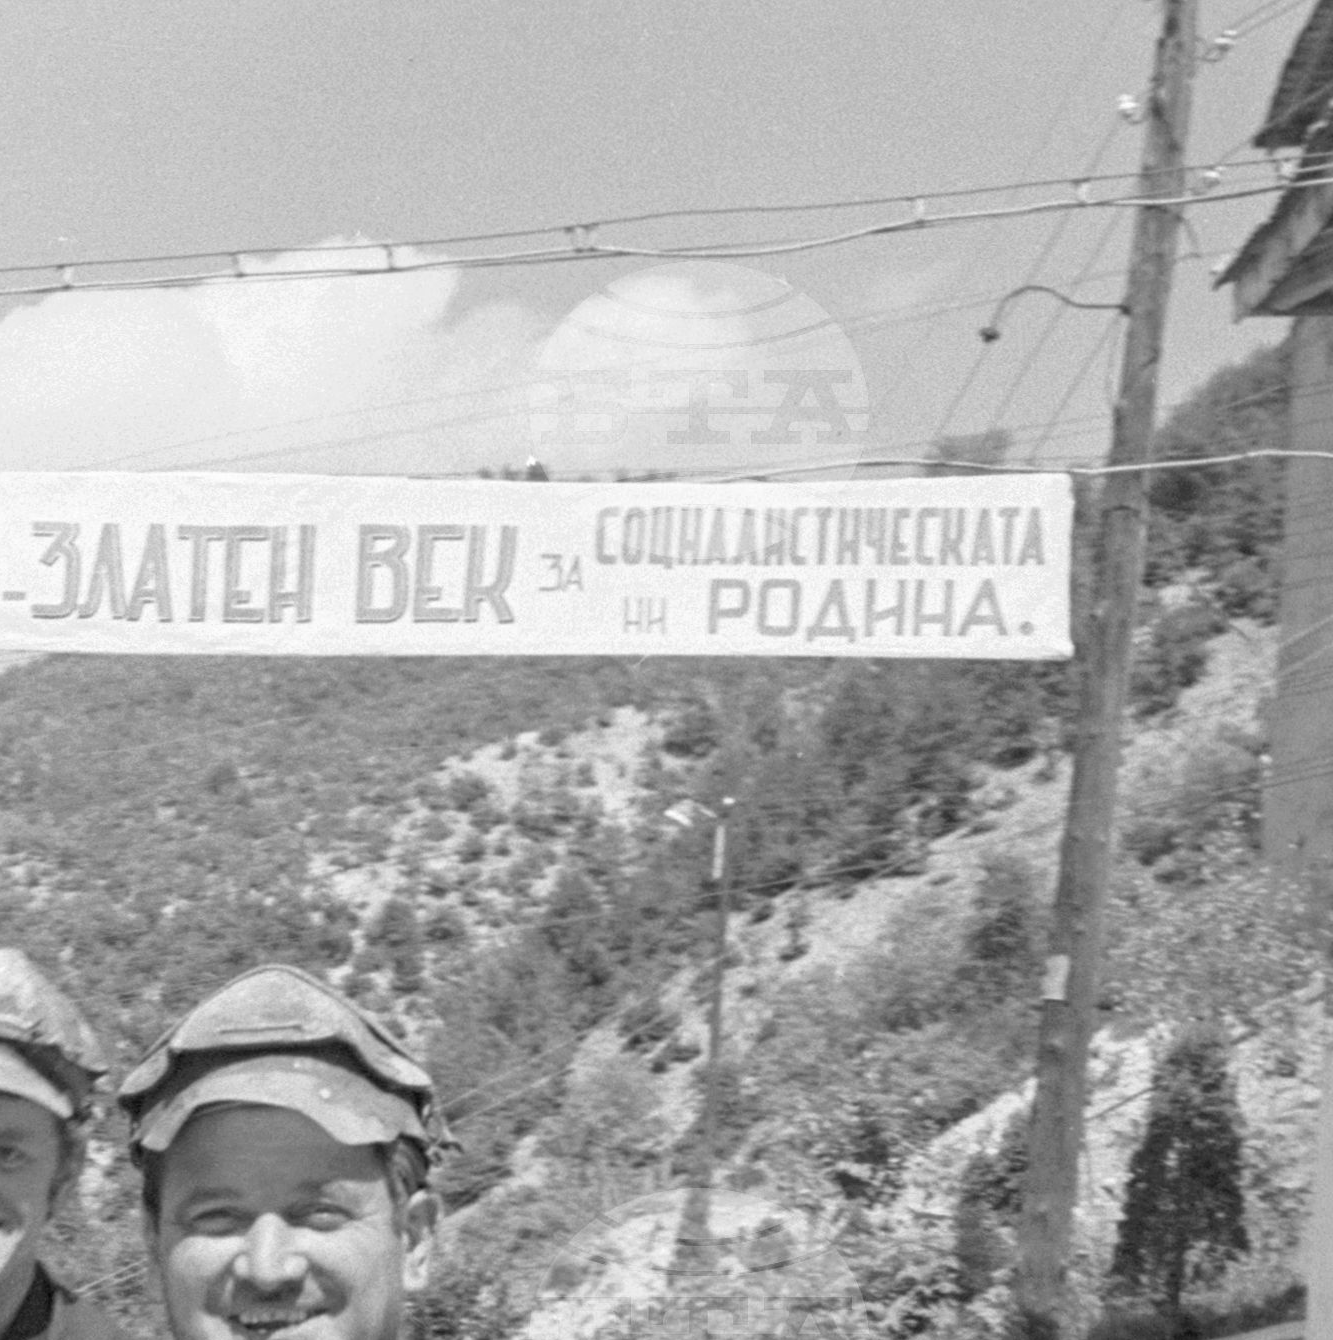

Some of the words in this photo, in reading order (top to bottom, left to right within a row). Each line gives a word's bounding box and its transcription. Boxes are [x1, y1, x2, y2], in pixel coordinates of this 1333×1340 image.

[595, 506, 1045, 569] СОЦИАЛИСТИЧЕСКАТА
[355, 525, 518, 624] ВЕК
[539, 554, 583, 592] ЗА
[623, 597, 667, 634] НИ
[708, 578, 1034, 643] РОДИНА.
